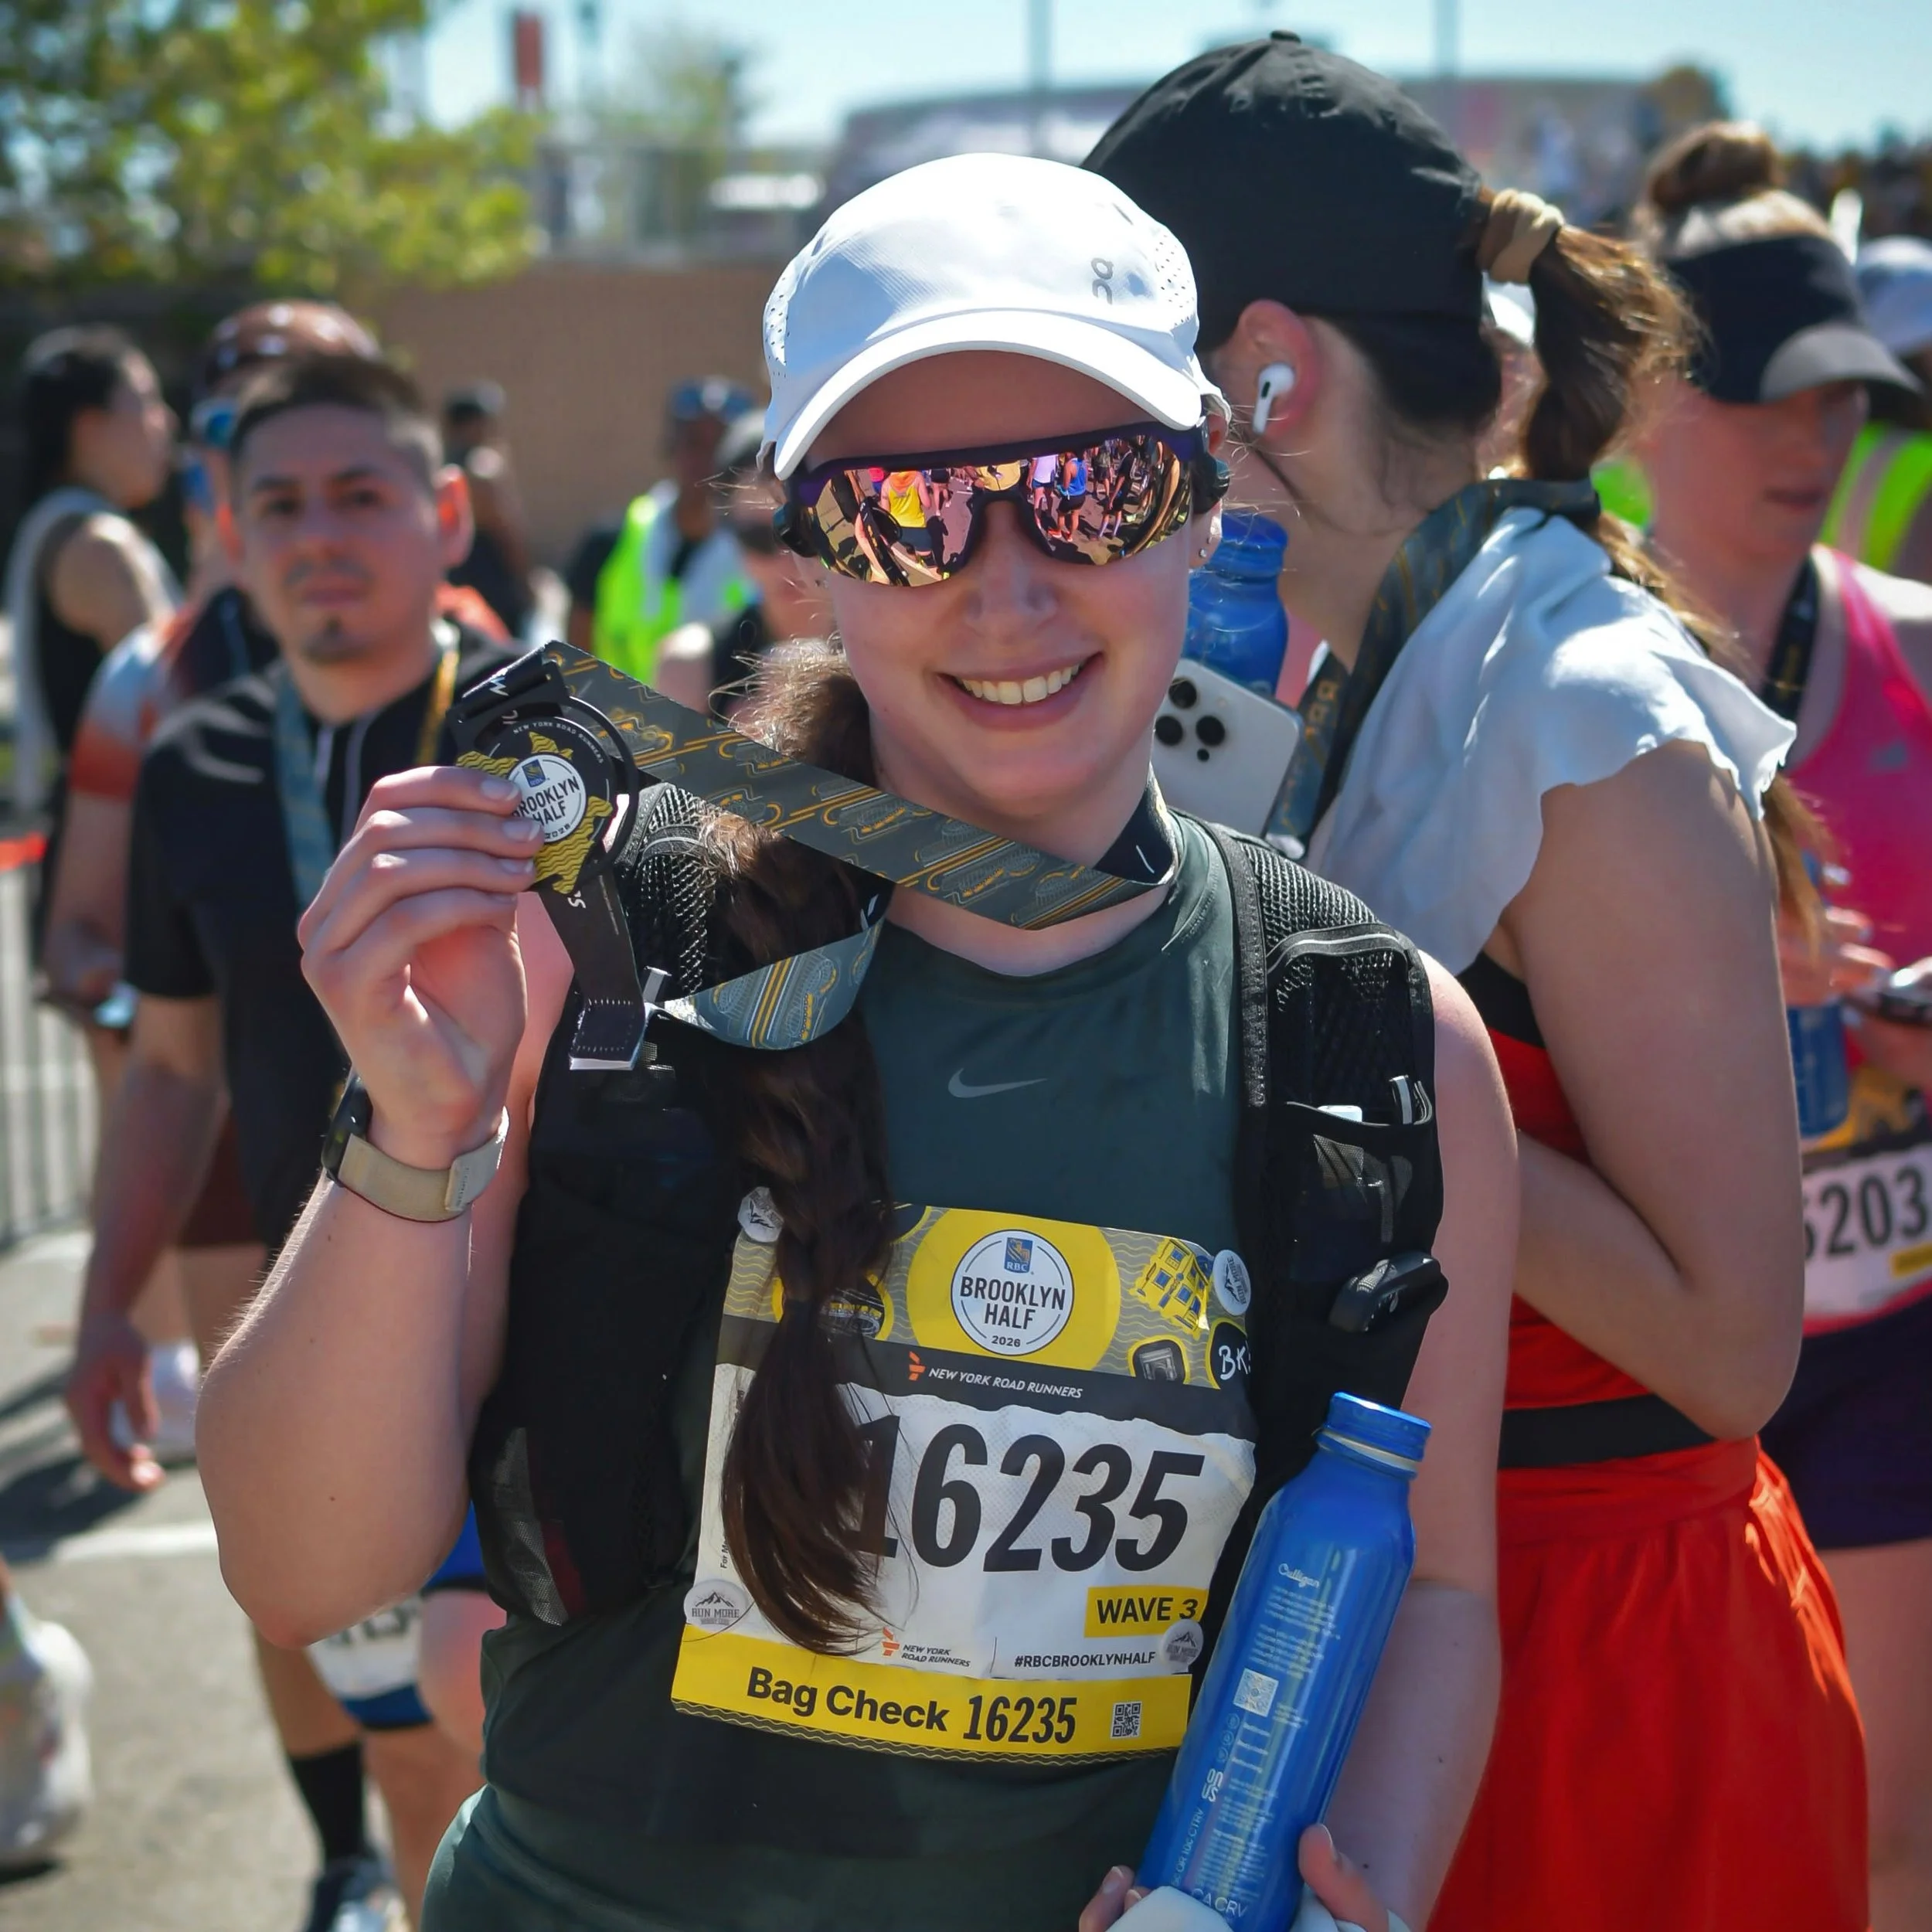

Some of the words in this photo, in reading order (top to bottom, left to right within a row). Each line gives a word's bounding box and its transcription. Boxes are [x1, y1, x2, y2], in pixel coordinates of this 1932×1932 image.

[513, 724, 529, 734] NEW
[556, 723, 577, 734] ROAD
[578, 733, 604, 764] RUNNERS
[1006, 1260, 1028, 1273] RBC
[960, 1276, 1066, 1311] BROOKLYN
[984, 1303, 1036, 1330] HALF
[991, 1335, 1021, 1348] 2026
[928, 1367, 957, 1381] NEW
[959, 1372, 993, 1386] YORK
[992, 1376, 1026, 1392] ROAD
[1027, 1381, 1083, 1399] RUNNERS
[855, 1415, 1206, 1573] 16235
[1278, 1563, 1320, 1588] Culligan
[692, 1607, 711, 1617] RUN
[714, 1608, 740, 1618] MORE
[1097, 1597, 1174, 1624] WAVE
[1179, 1598, 1199, 1621] 3
[901, 1652, 927, 1662] ROAD
[928, 1655, 971, 1667] RUNNERS
[903, 1645, 925, 1654] NEW
[927, 1647, 951, 1656] YORK
[1014, 1651, 1156, 1668] #RBCBROOKLYNHALF
[747, 1666, 818, 1717] Bag
[825, 1685, 950, 1732] Check
[962, 1694, 1078, 1743] 16235
[1175, 1855, 1188, 1872] OR
[1214, 1896, 1248, 1917] CRV
